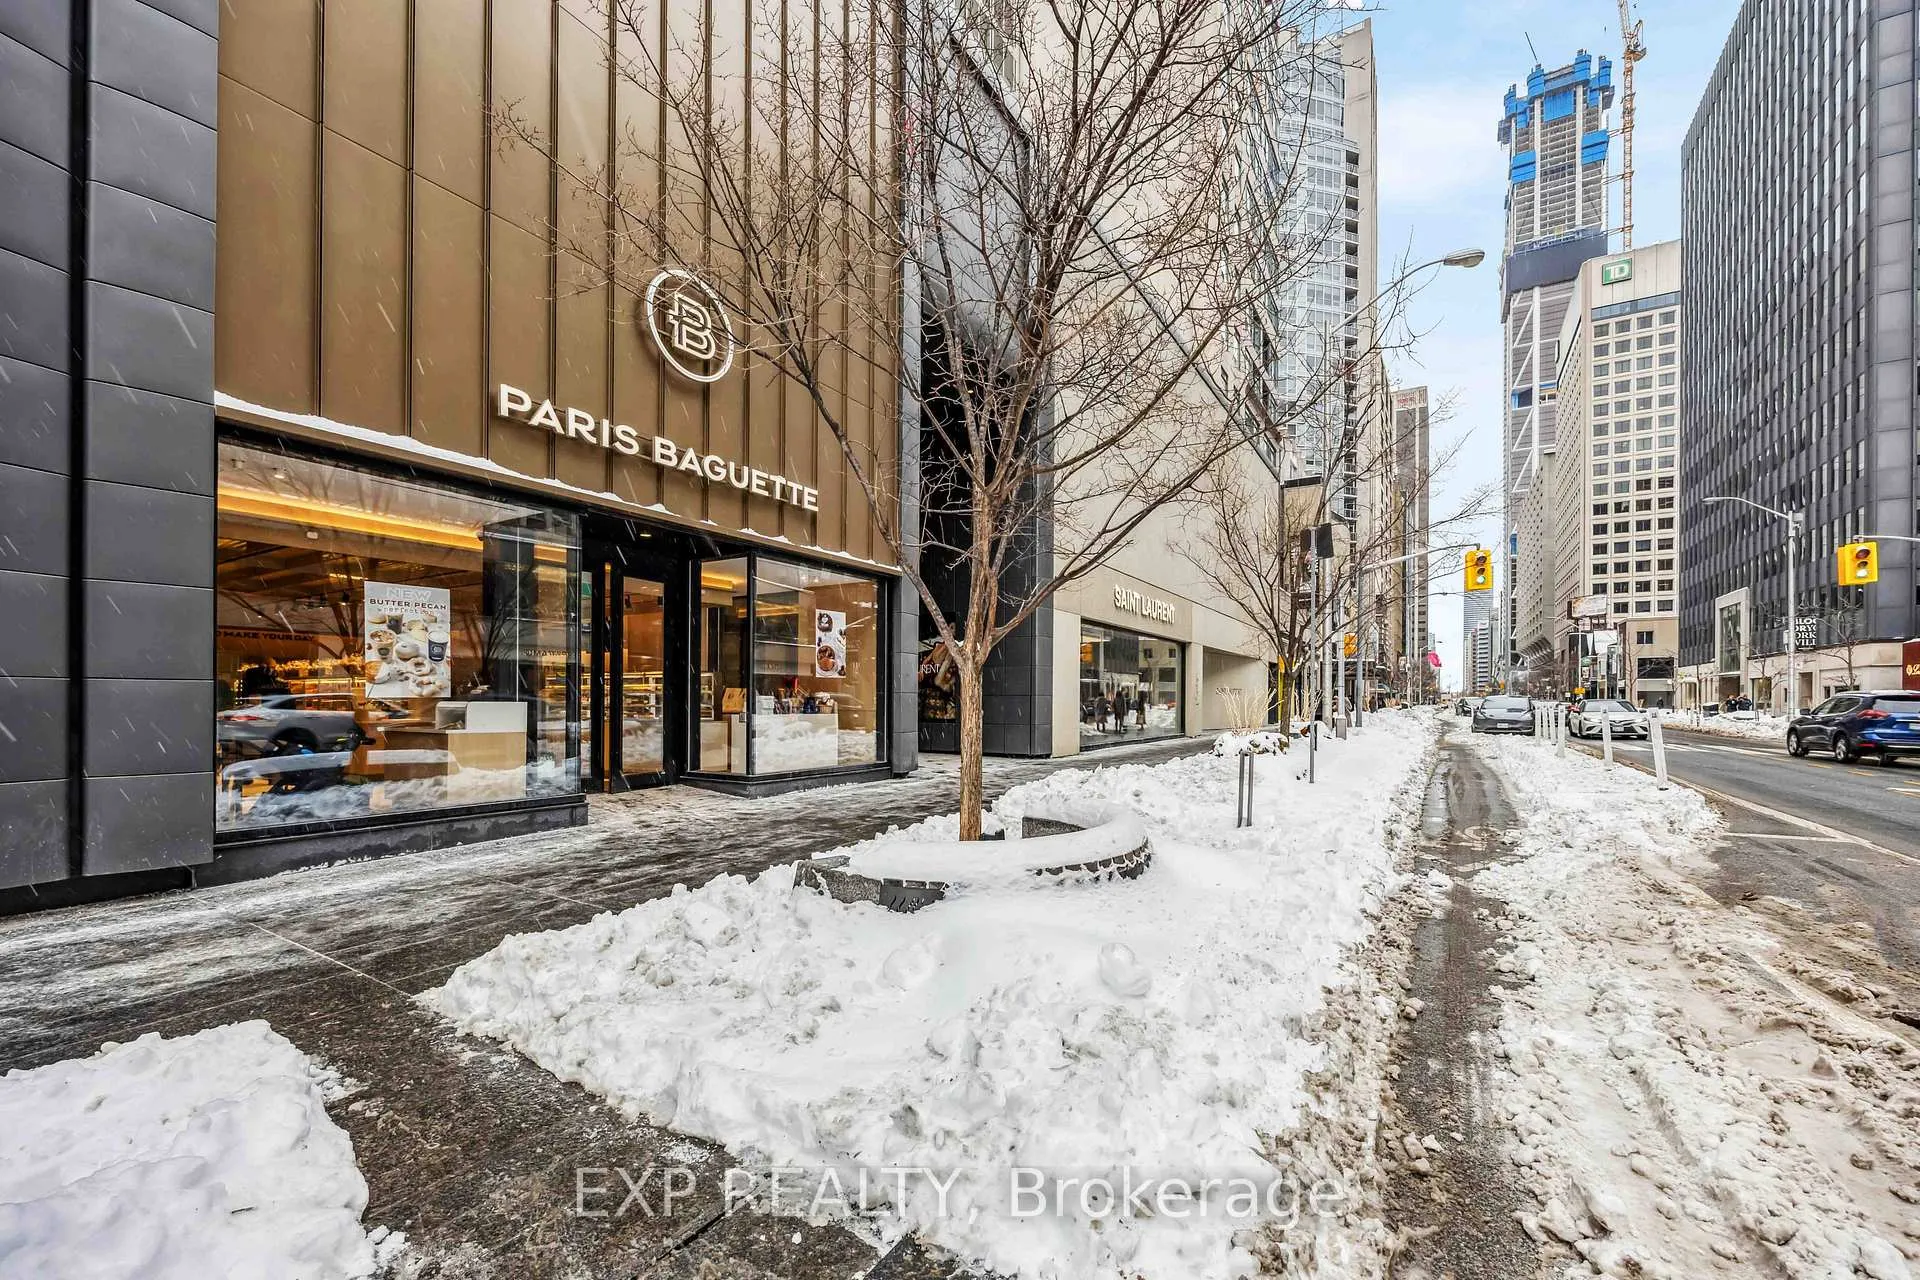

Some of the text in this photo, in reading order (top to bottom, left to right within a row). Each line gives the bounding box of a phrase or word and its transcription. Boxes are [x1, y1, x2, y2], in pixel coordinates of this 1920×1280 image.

[1605, 264, 1628, 280] TD
[498, 383, 819, 512] PARIS BAGUETTE
[386, 586, 432, 601] NEW
[369, 598, 447, 610] BUTTER PECAN
[1114, 584, 1175, 624] SAINT LAURENT
[223, 631, 259, 639] MAKE
[262, 632, 293, 641] YOUR
[920, 663, 940, 674] RENT
